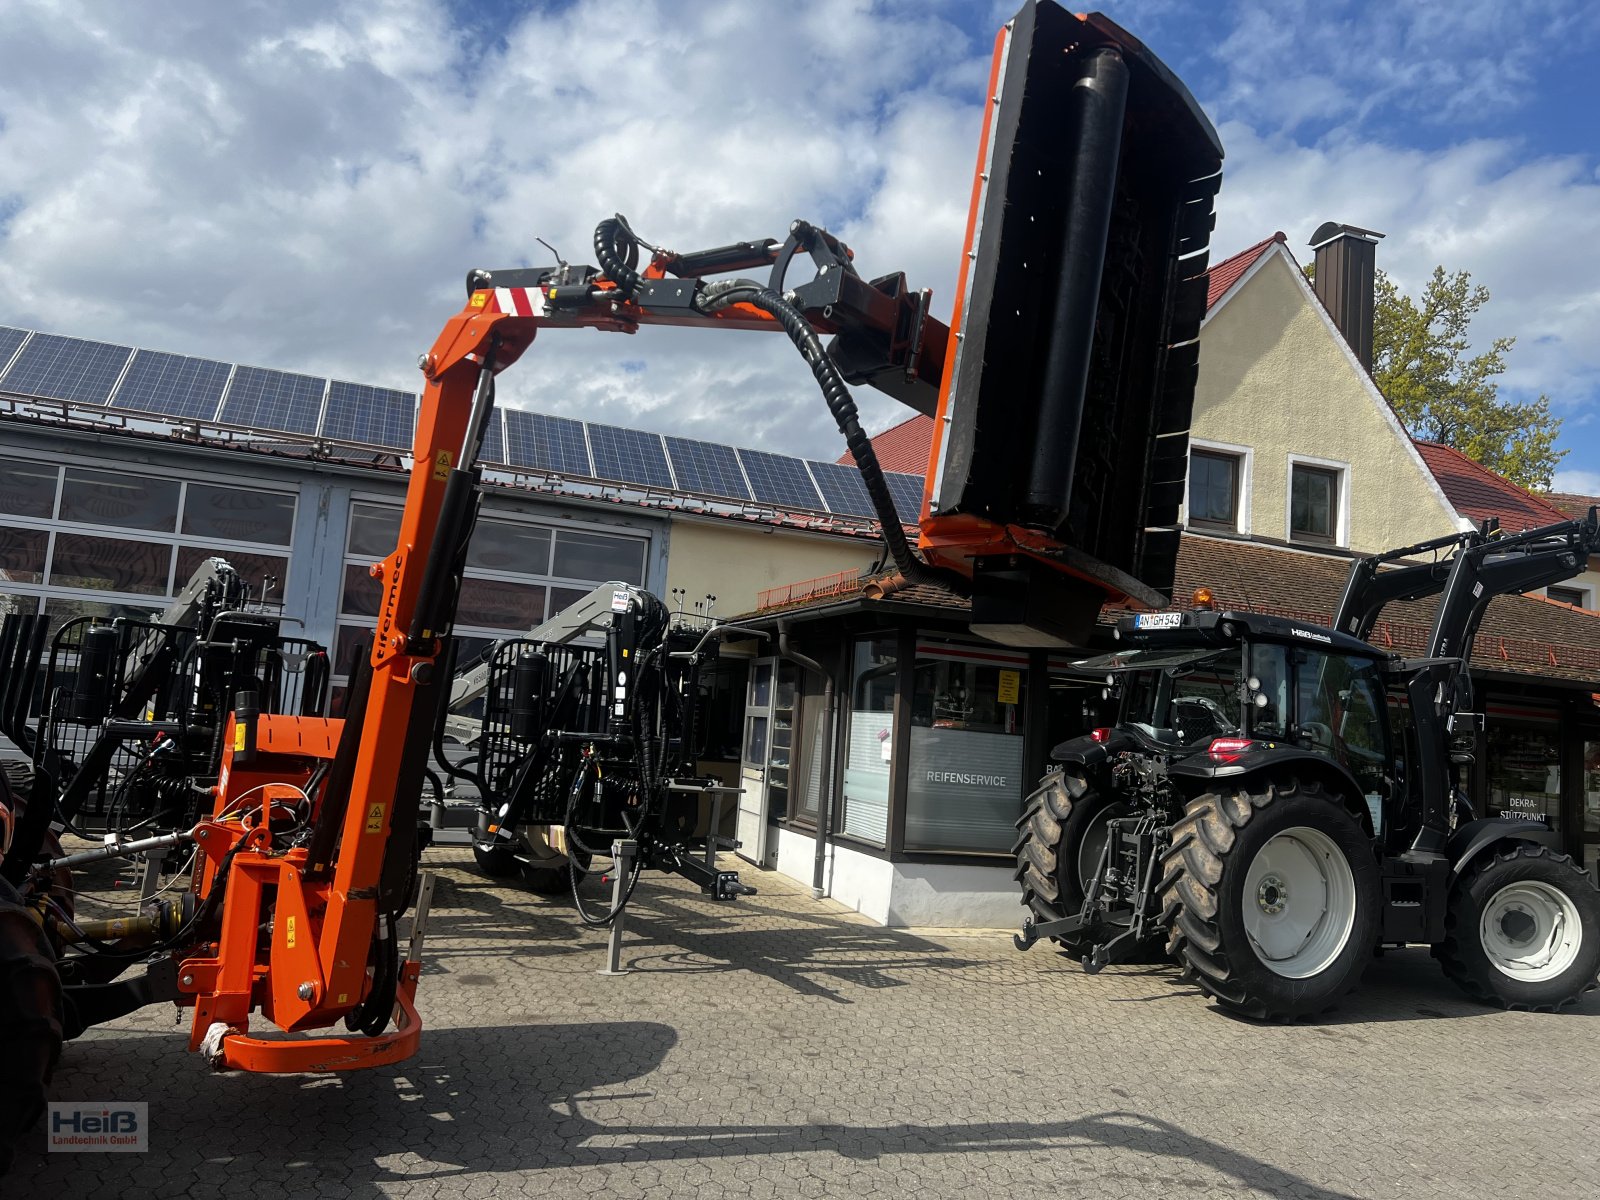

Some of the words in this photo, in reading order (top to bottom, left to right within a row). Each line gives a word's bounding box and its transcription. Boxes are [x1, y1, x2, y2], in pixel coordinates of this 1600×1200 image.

[376, 555, 403, 660] tifermec
[1140, 615, 1150, 626] AN
[926, 770, 1007, 787] REIFENSERVICE
[1509, 797, 1537, 808] DEKRA-
[1500, 809, 1547, 822] STÜTZPUNKT
